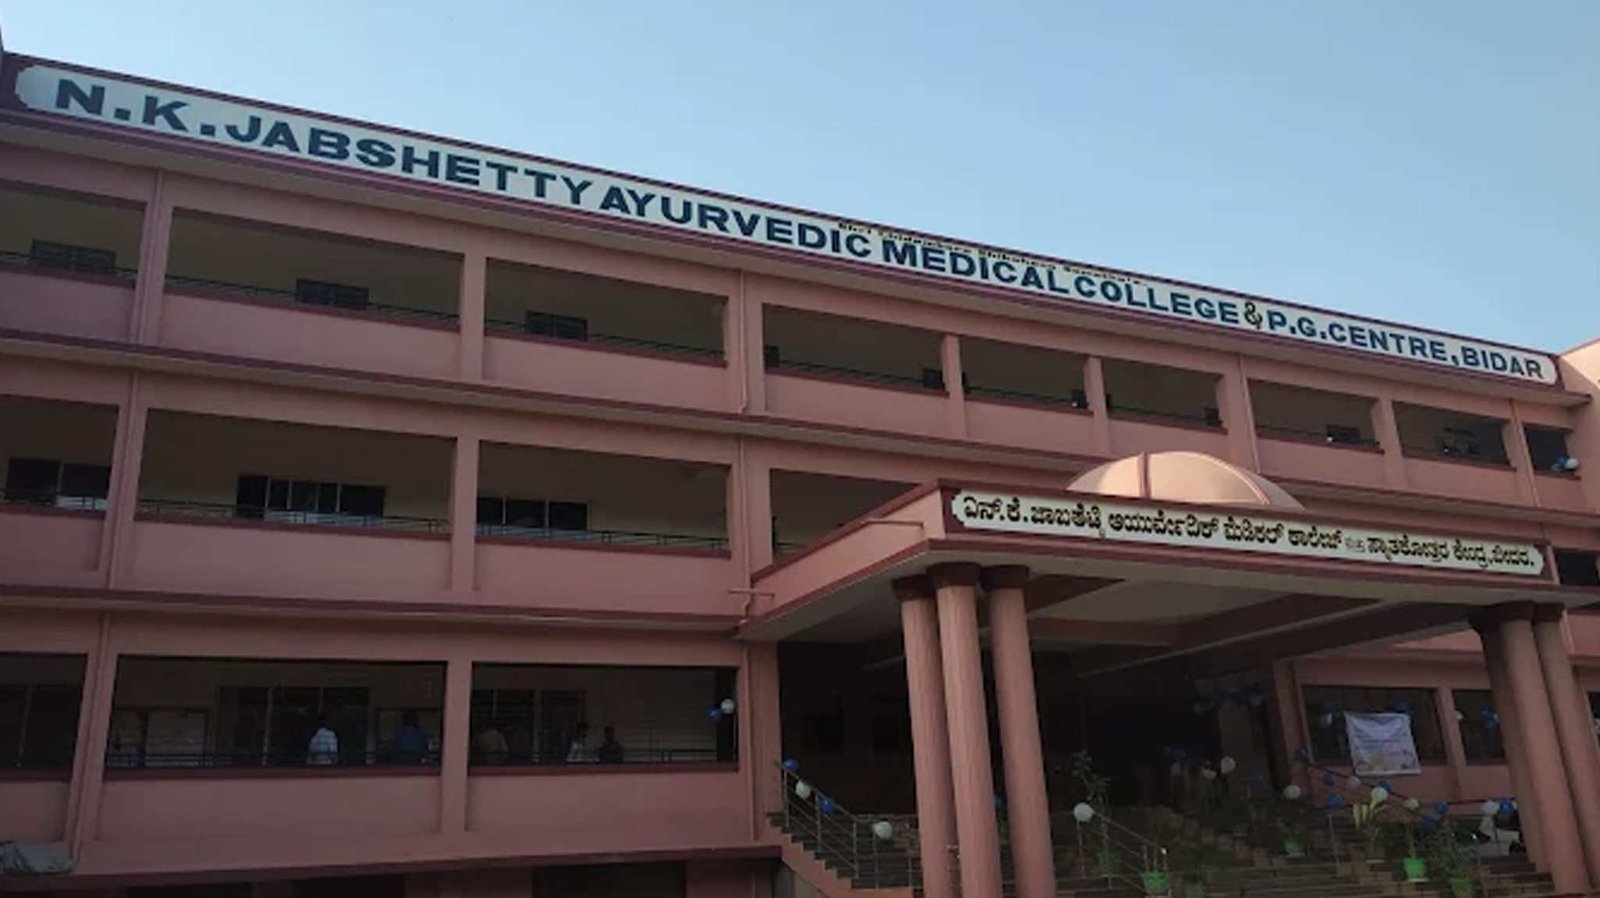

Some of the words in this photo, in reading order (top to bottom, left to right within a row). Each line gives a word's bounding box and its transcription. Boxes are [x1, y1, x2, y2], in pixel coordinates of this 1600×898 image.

[599, 186, 871, 258] AYURVEDIC
[882, 240, 1069, 295] MEDICAL
[1073, 275, 1239, 325] COLLEGE
[1243, 301, 1263, 330] &
